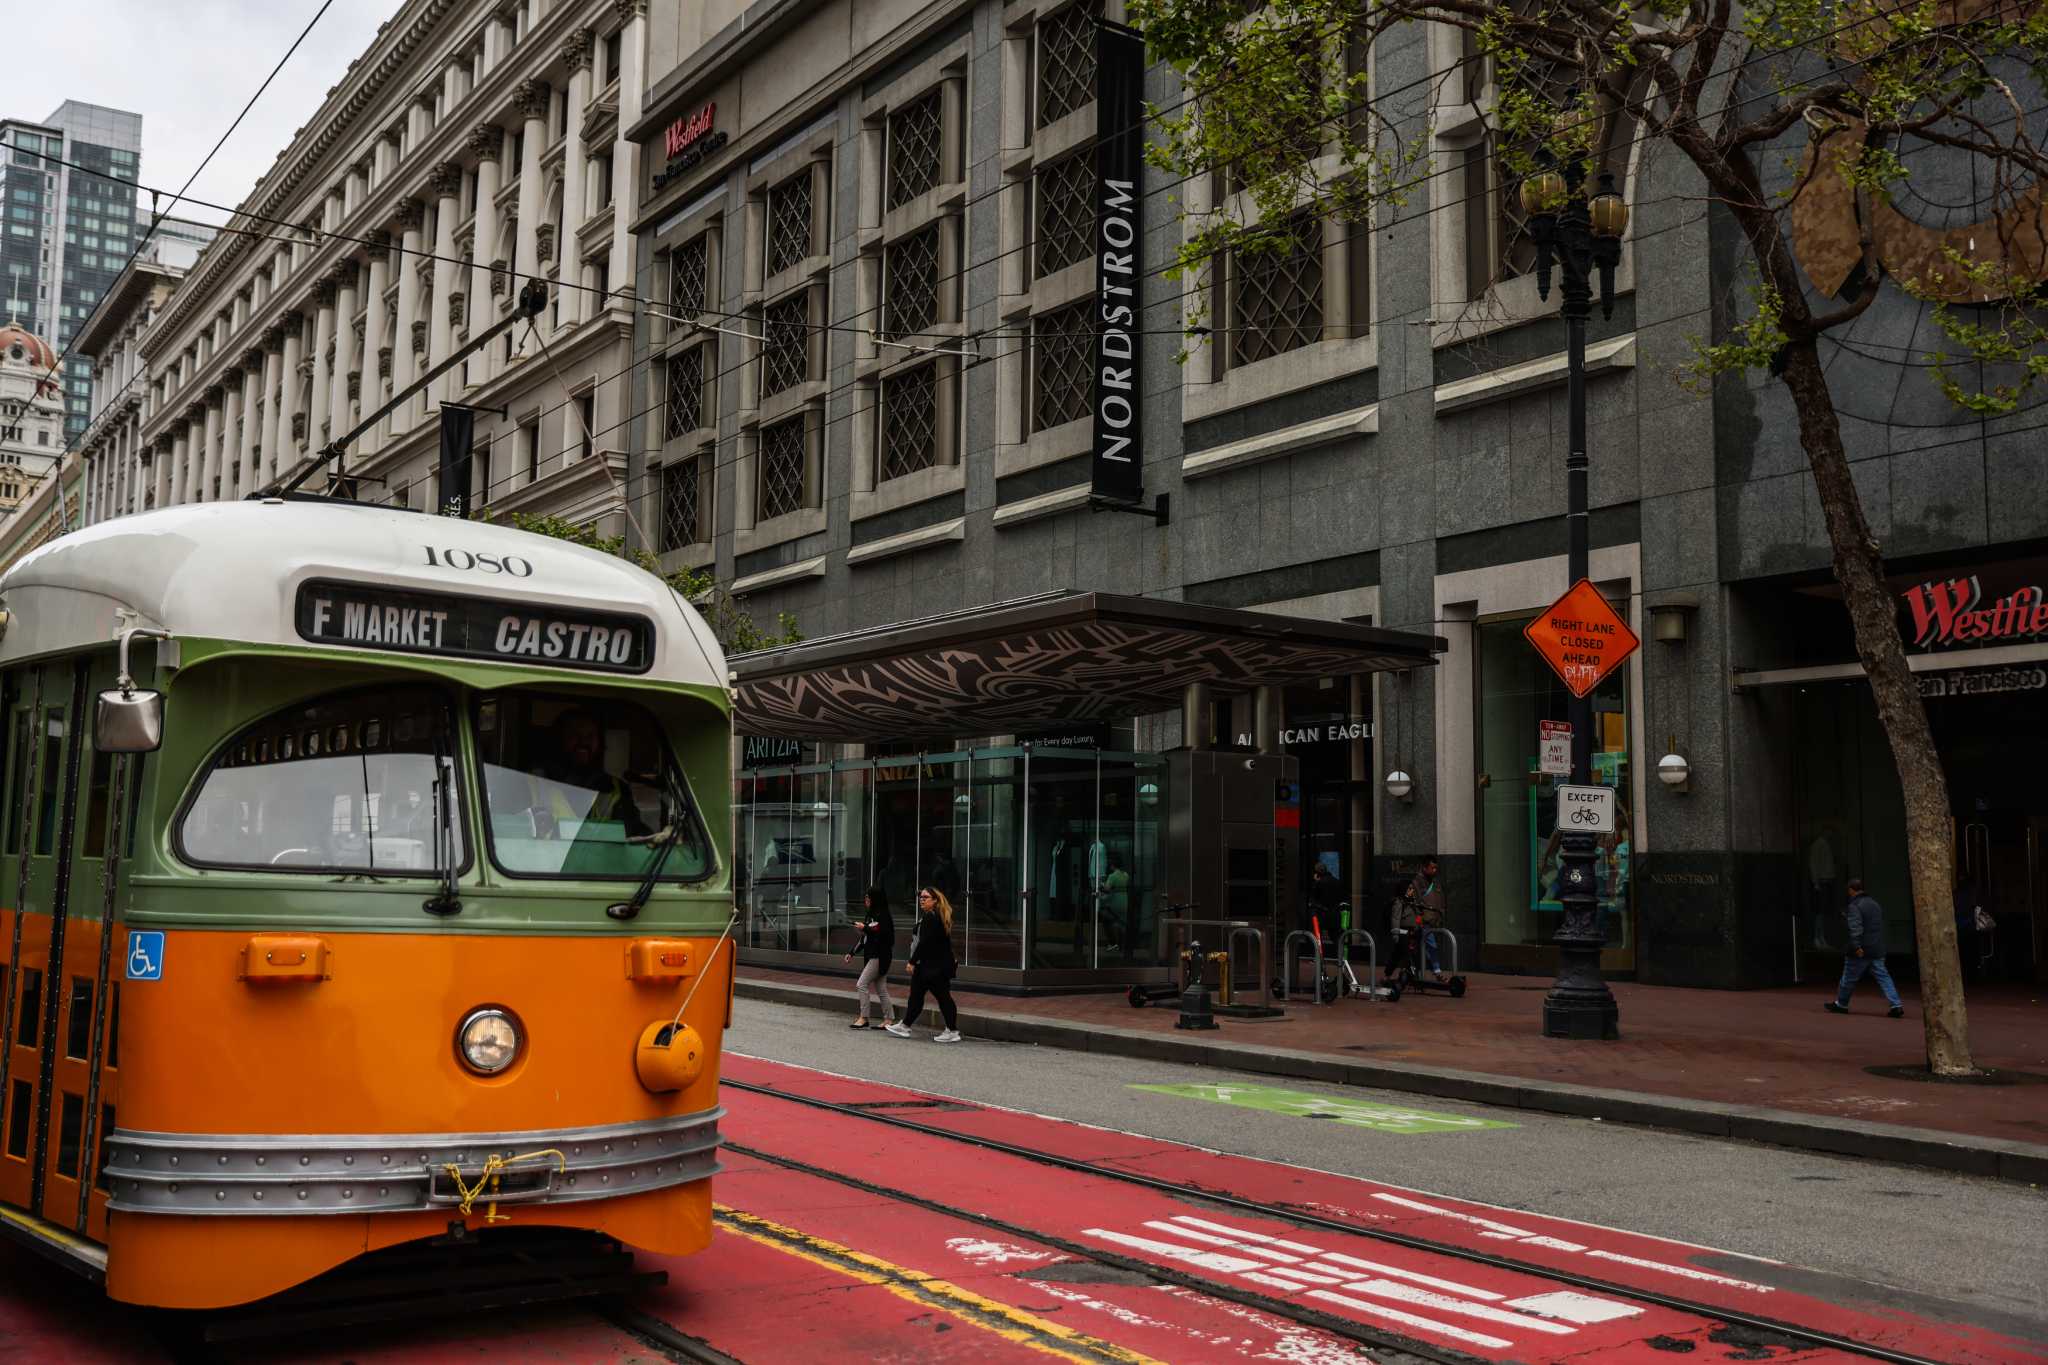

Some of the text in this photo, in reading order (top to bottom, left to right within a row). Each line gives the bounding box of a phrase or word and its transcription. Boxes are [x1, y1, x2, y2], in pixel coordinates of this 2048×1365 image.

[665, 102, 716, 160] Westfield
[1101, 178, 1134, 463] NORDSTROM
[423, 545, 533, 578] 1080
[313, 598, 633, 665] F MARKET CASTRO
[1551, 618, 1616, 635] RIGHT LANE
[1560, 636, 1604, 650] CLOSED
[1562, 653, 1600, 666] AHEAD
[1948, 667, 2046, 696] Francisco
[1237, 727, 1320, 746] AICAN
[1541, 729, 1550, 740] NO
[746, 736, 800, 760] ARITZIA
[1549, 745, 1562, 754] ANY
[1548, 754, 1564, 763] TIME
[1567, 793, 1606, 804] EXCEPT
